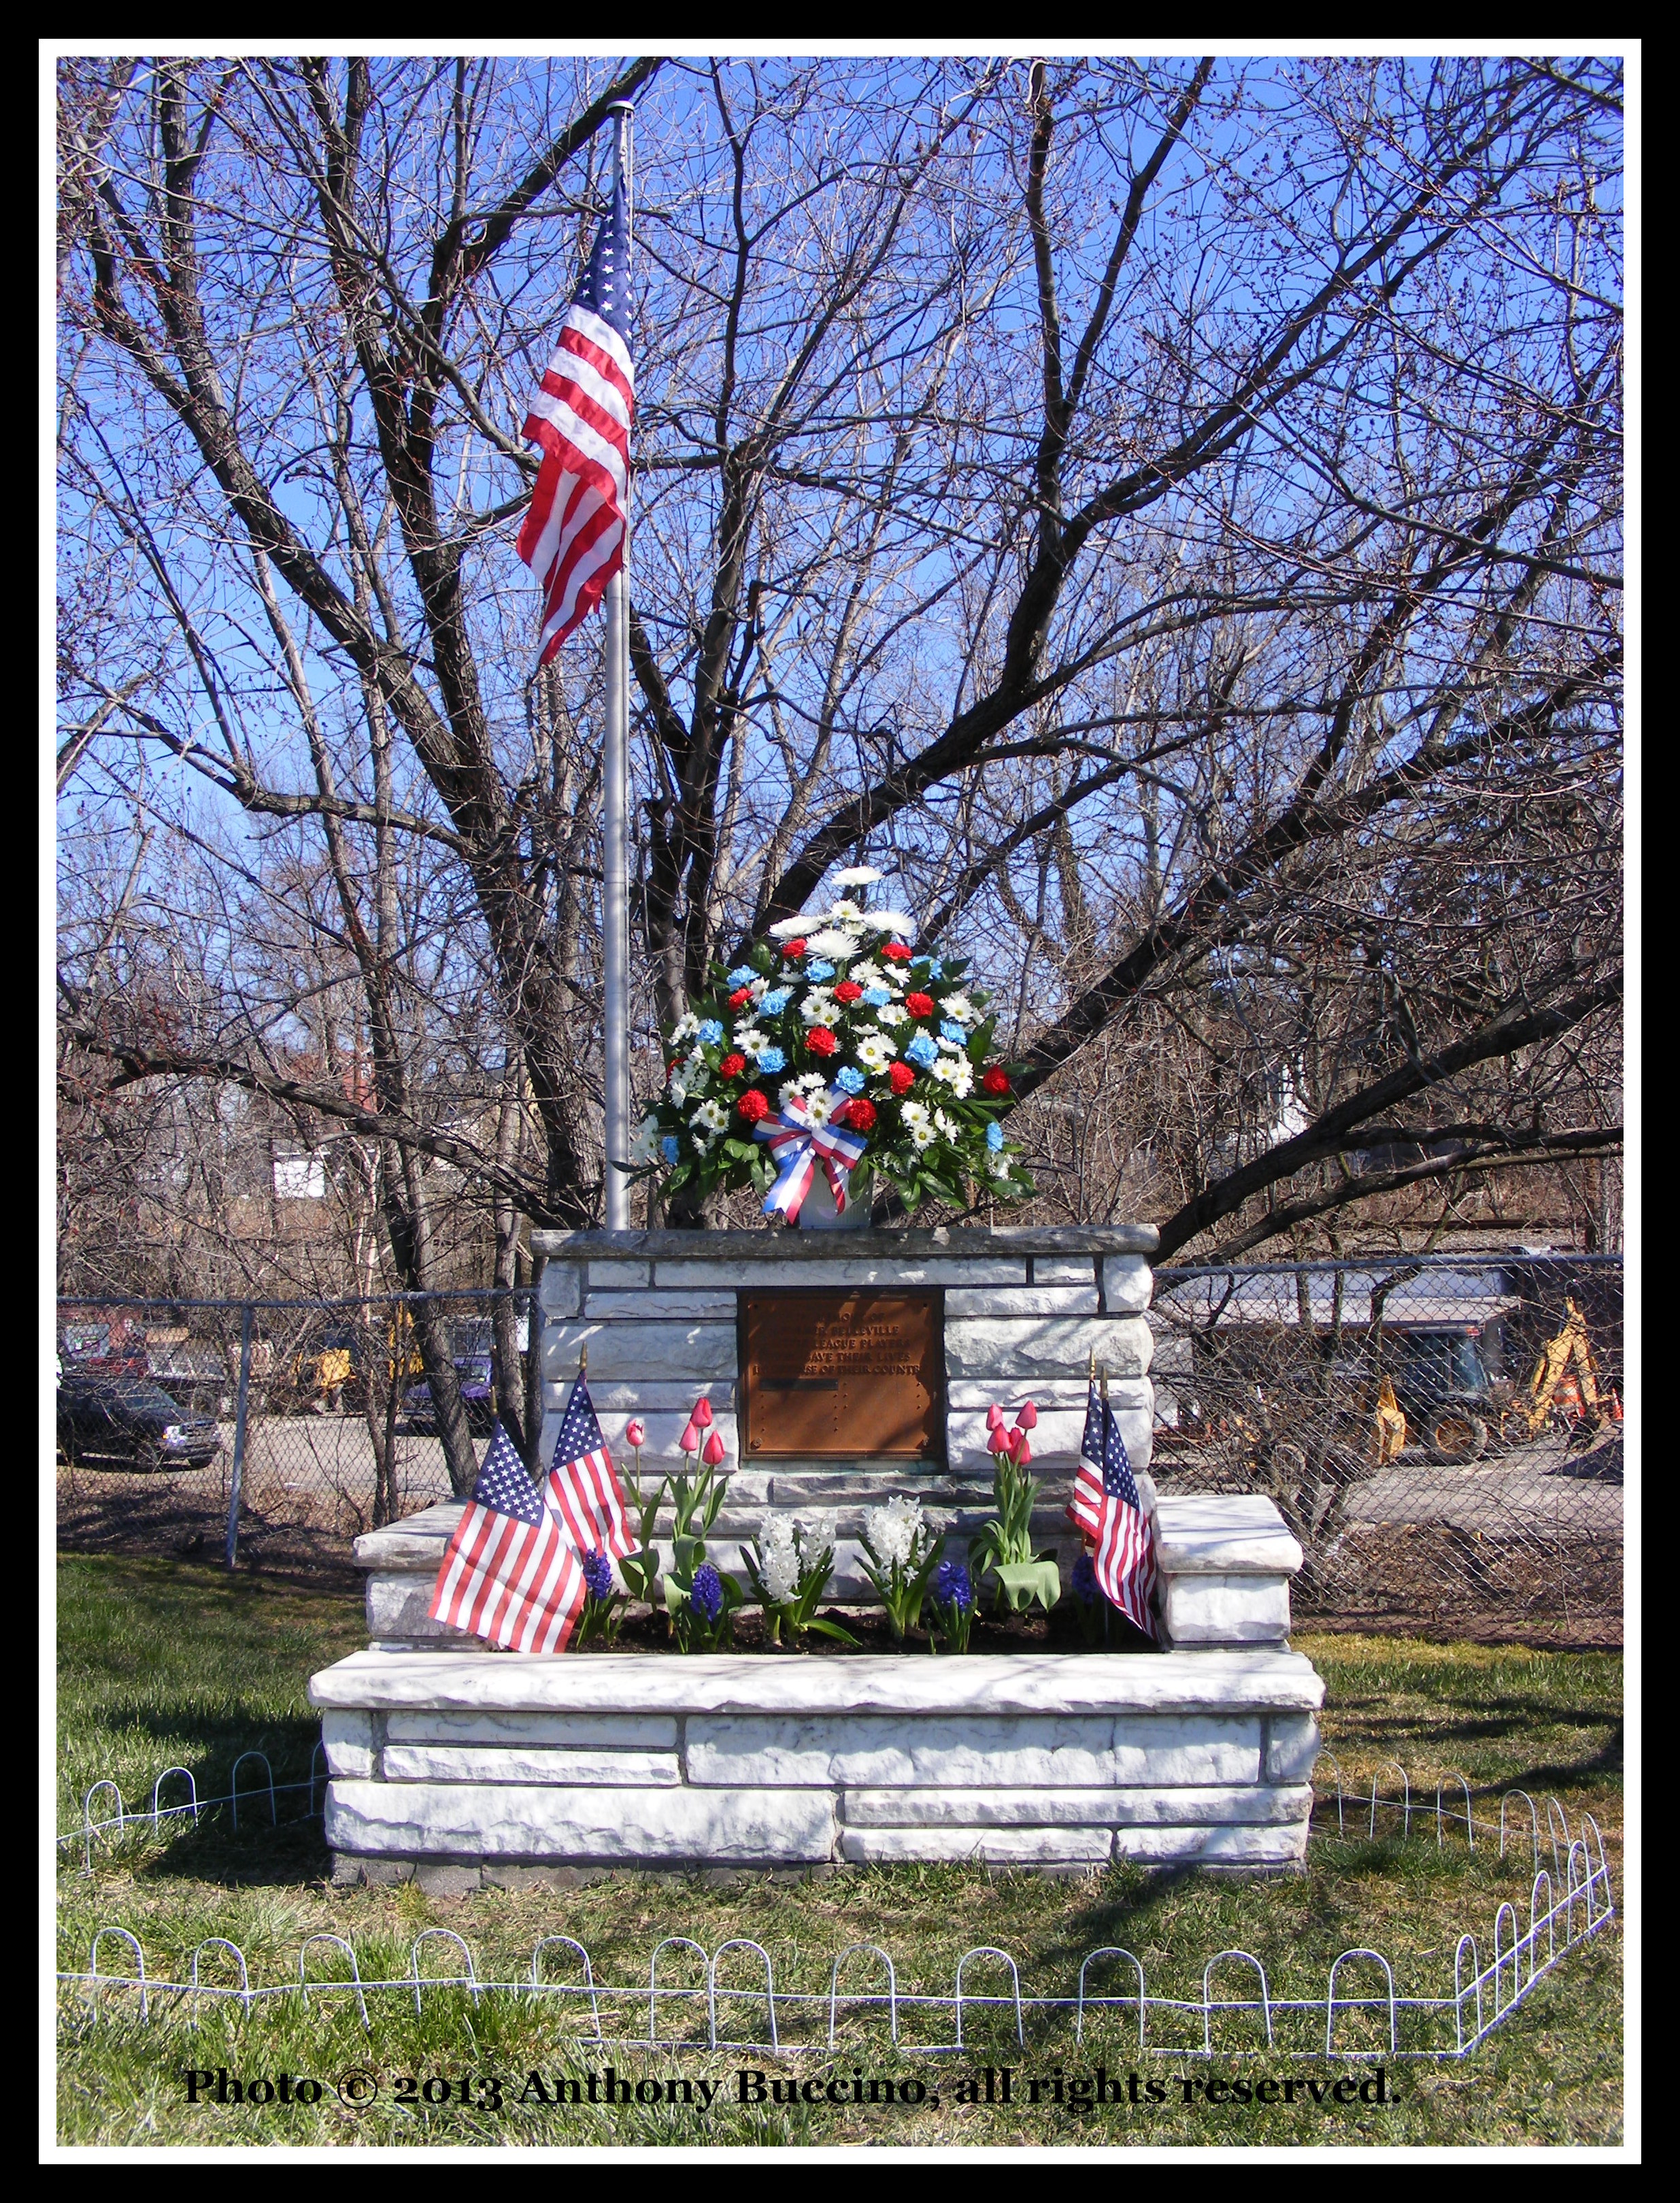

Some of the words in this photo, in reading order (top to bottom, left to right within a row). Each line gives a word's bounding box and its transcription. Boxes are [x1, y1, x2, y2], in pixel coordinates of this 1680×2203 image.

[830, 1325, 899, 1336] BELLEVILLE
[815, 1338, 856, 1350] LEAGUE
[860, 1338, 910, 1348] PLAYERS
[837, 1352, 873, 1362] THEIR
[877, 1352, 910, 1362] LIVES
[820, 1365, 835, 1374] OF
[838, 1365, 871, 1374] THEIR
